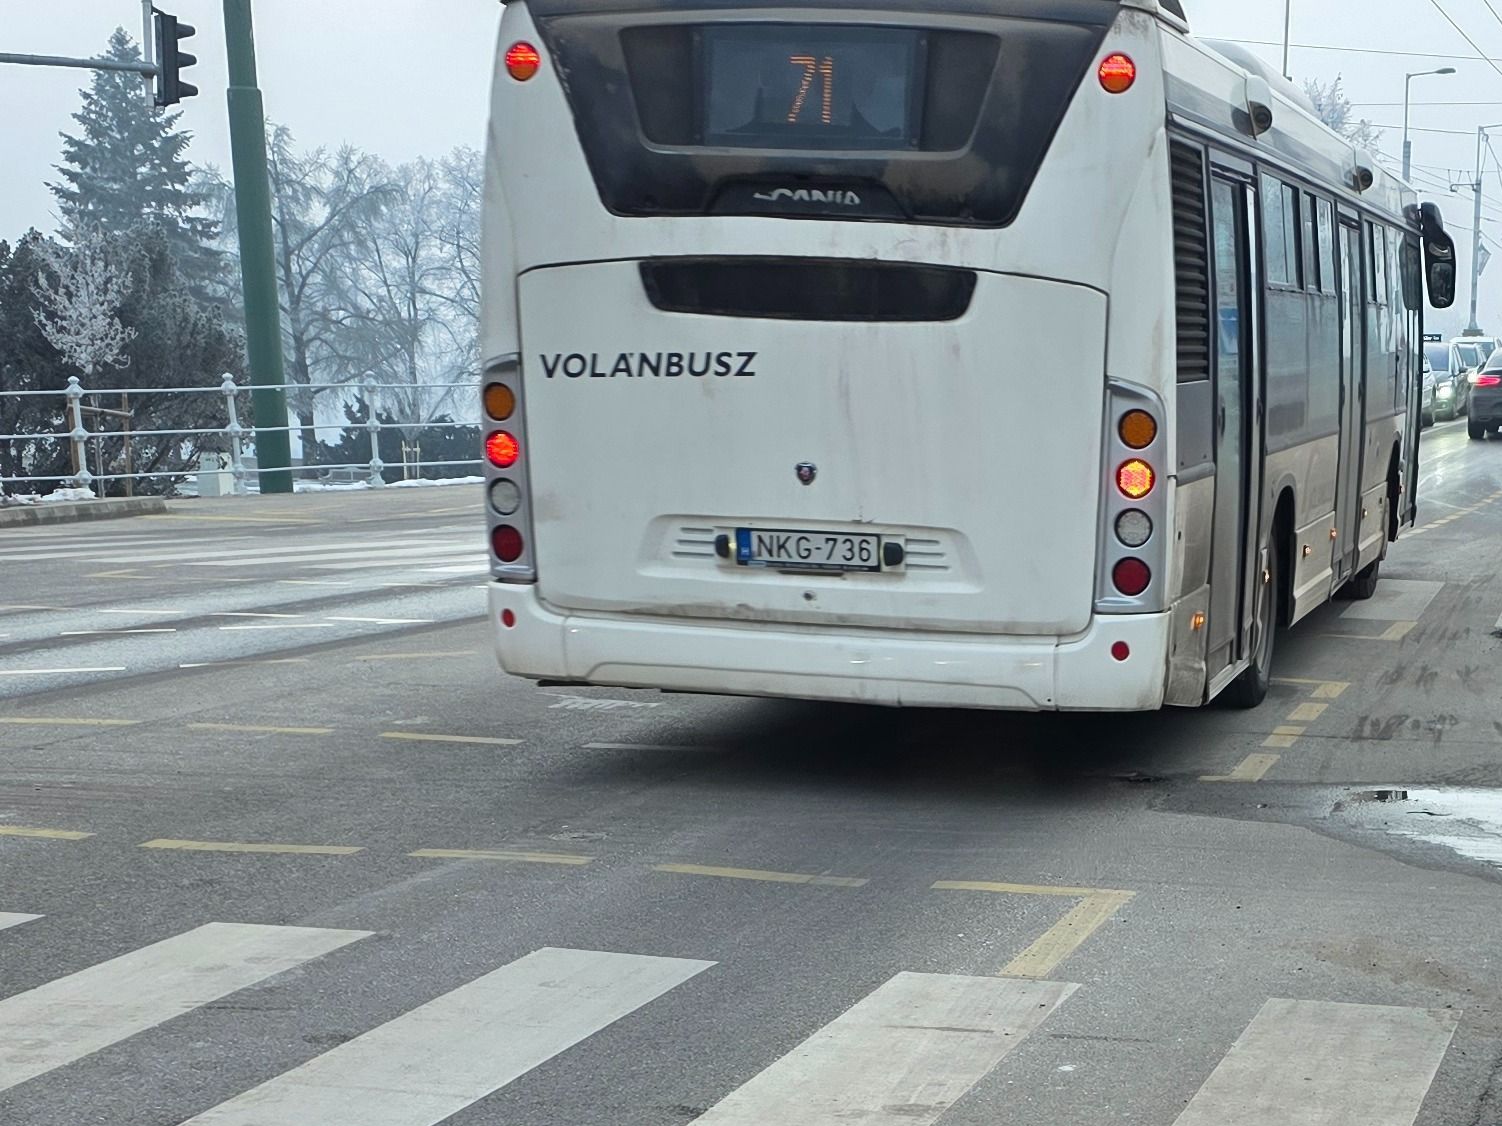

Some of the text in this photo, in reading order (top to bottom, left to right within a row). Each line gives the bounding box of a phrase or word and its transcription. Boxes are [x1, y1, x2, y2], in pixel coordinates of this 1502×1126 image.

[787, 55, 833, 124] 71
[539, 350, 759, 379] VOLÁNBUSZ
[756, 534, 872, 563] NKG-736
